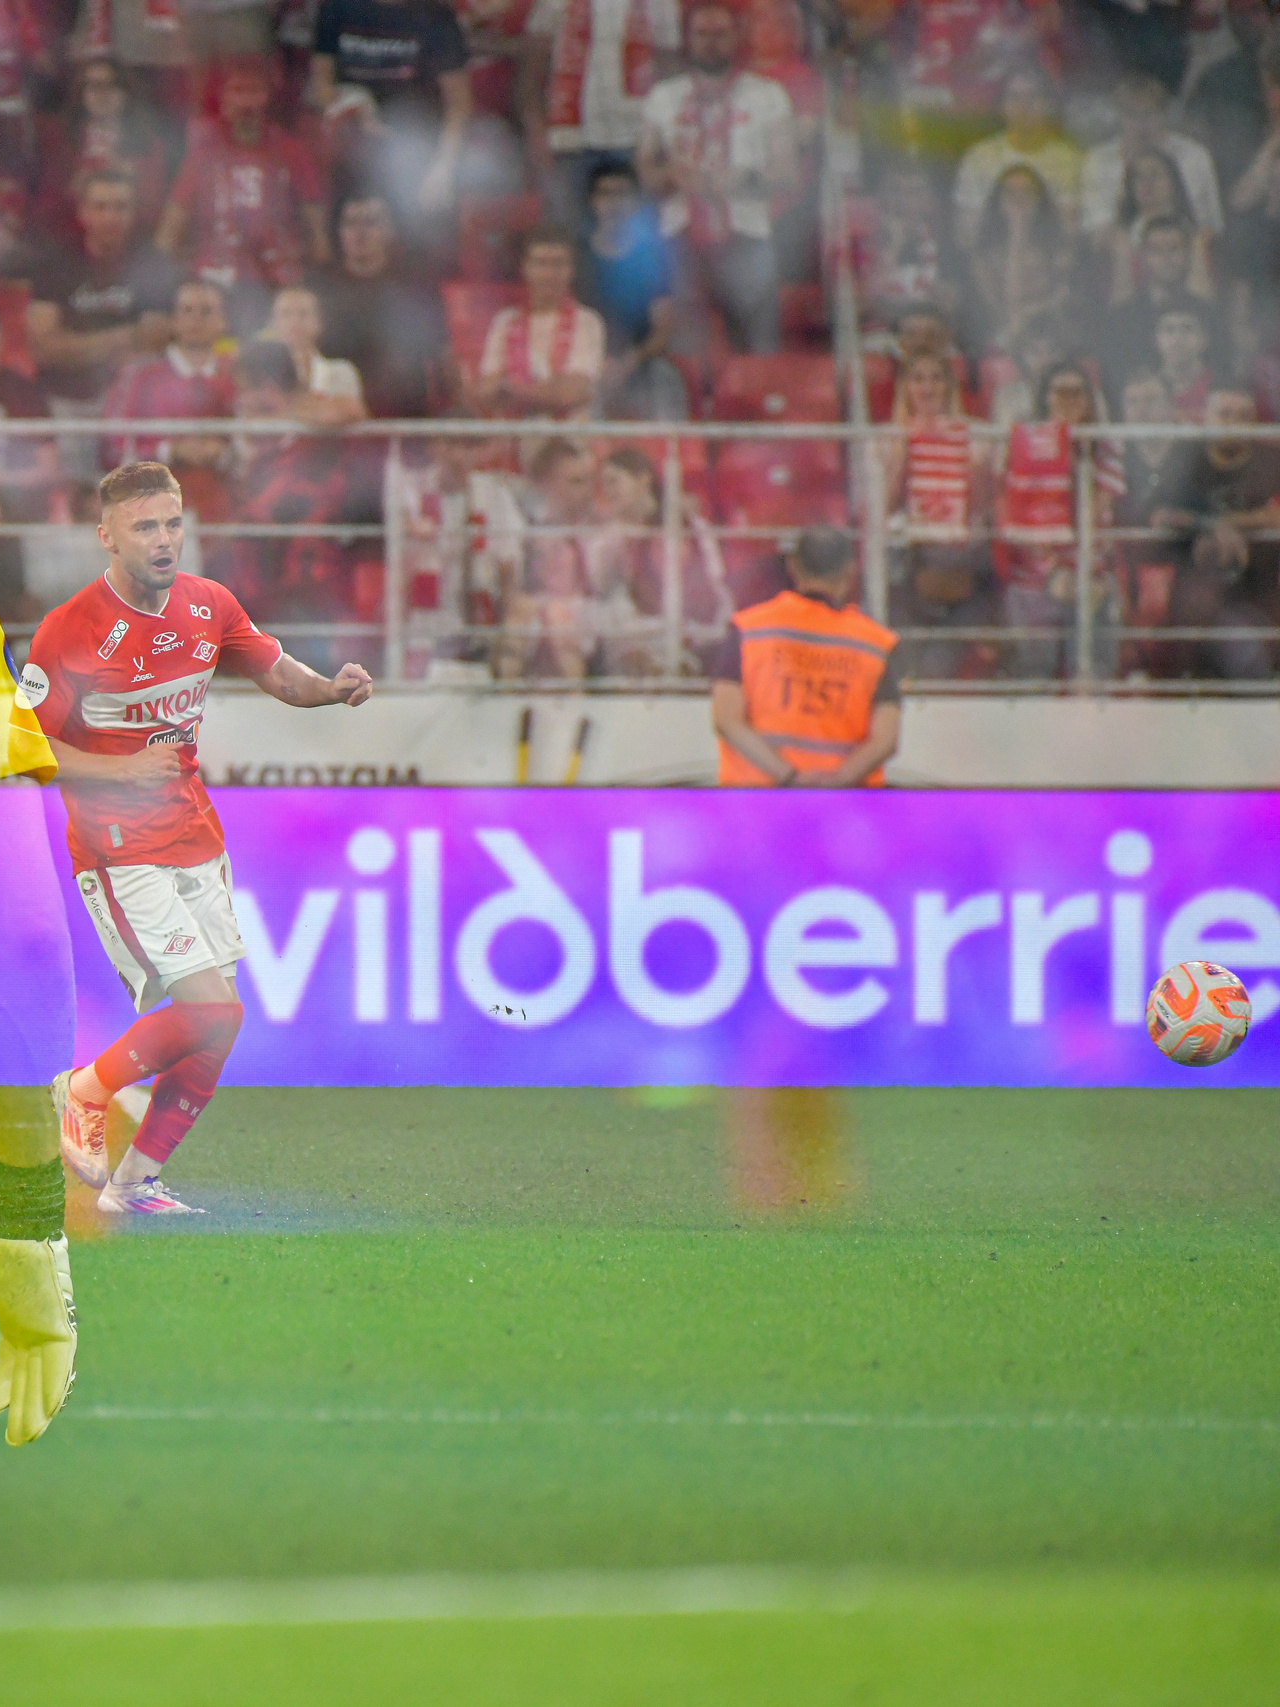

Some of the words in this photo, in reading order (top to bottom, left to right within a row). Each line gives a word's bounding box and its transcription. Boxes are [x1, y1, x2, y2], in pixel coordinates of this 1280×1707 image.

[189, 603, 212, 620] BQ
[110, 621, 128, 644] 100
[151, 640, 185, 655] CHERY
[122, 679, 210, 723] ЛУКОЙ
